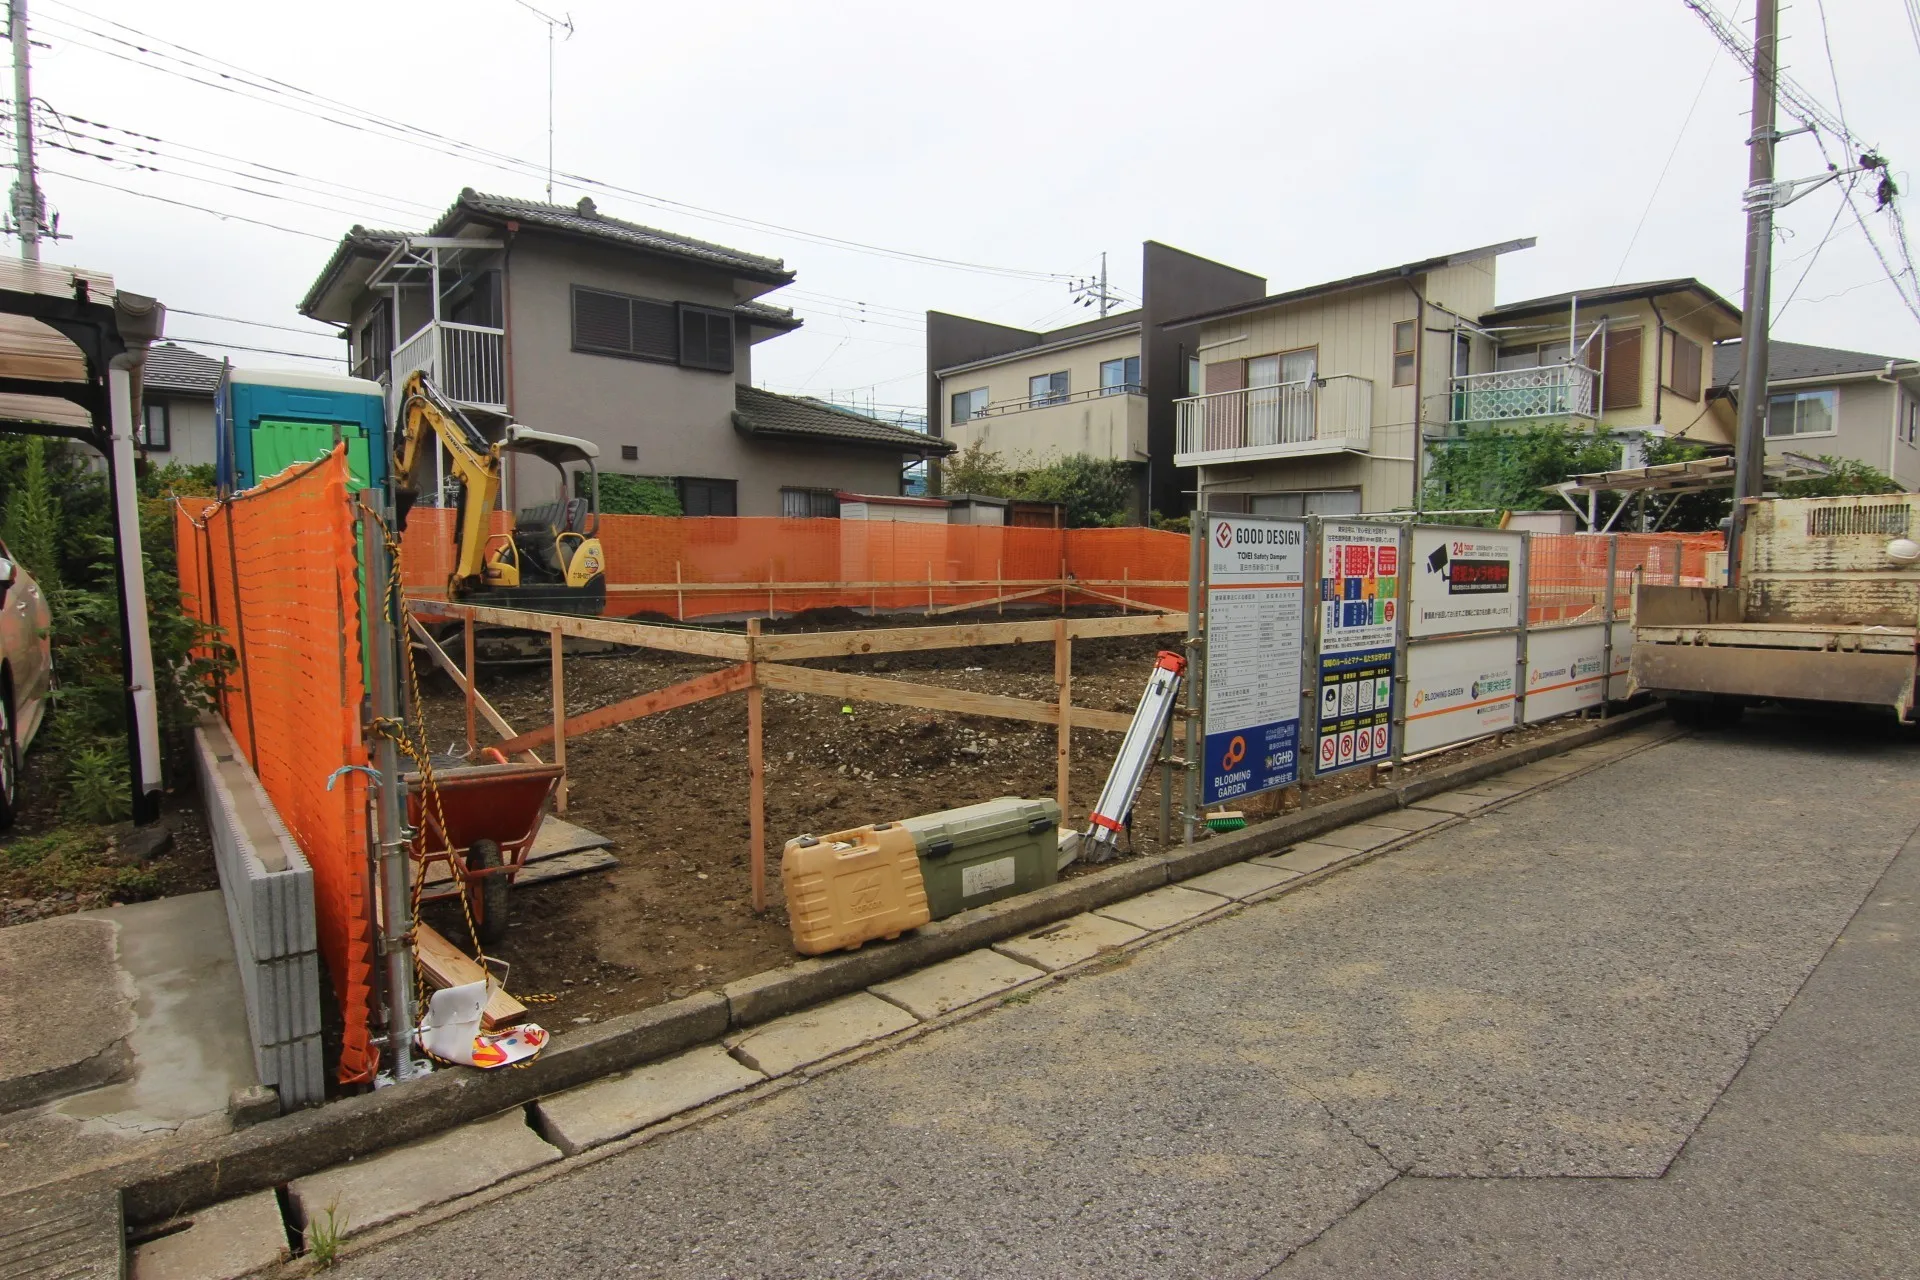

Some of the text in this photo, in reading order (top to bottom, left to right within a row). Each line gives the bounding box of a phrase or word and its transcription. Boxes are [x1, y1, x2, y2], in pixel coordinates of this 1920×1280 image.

[445, 432, 463, 454] YANMAR
[1236, 528, 1300, 545] GOOD DESIGN
[1453, 541, 1464, 556] 24
[1464, 543, 1473, 551] hour
[1254, 553, 1269, 561] Safety
[1270, 553, 1287, 562] Damper
[1424, 688, 1464, 701] BLOOMING GARDEN
[1214, 770, 1251, 787] BLOOMING
[1218, 782, 1247, 798] GARDEN
